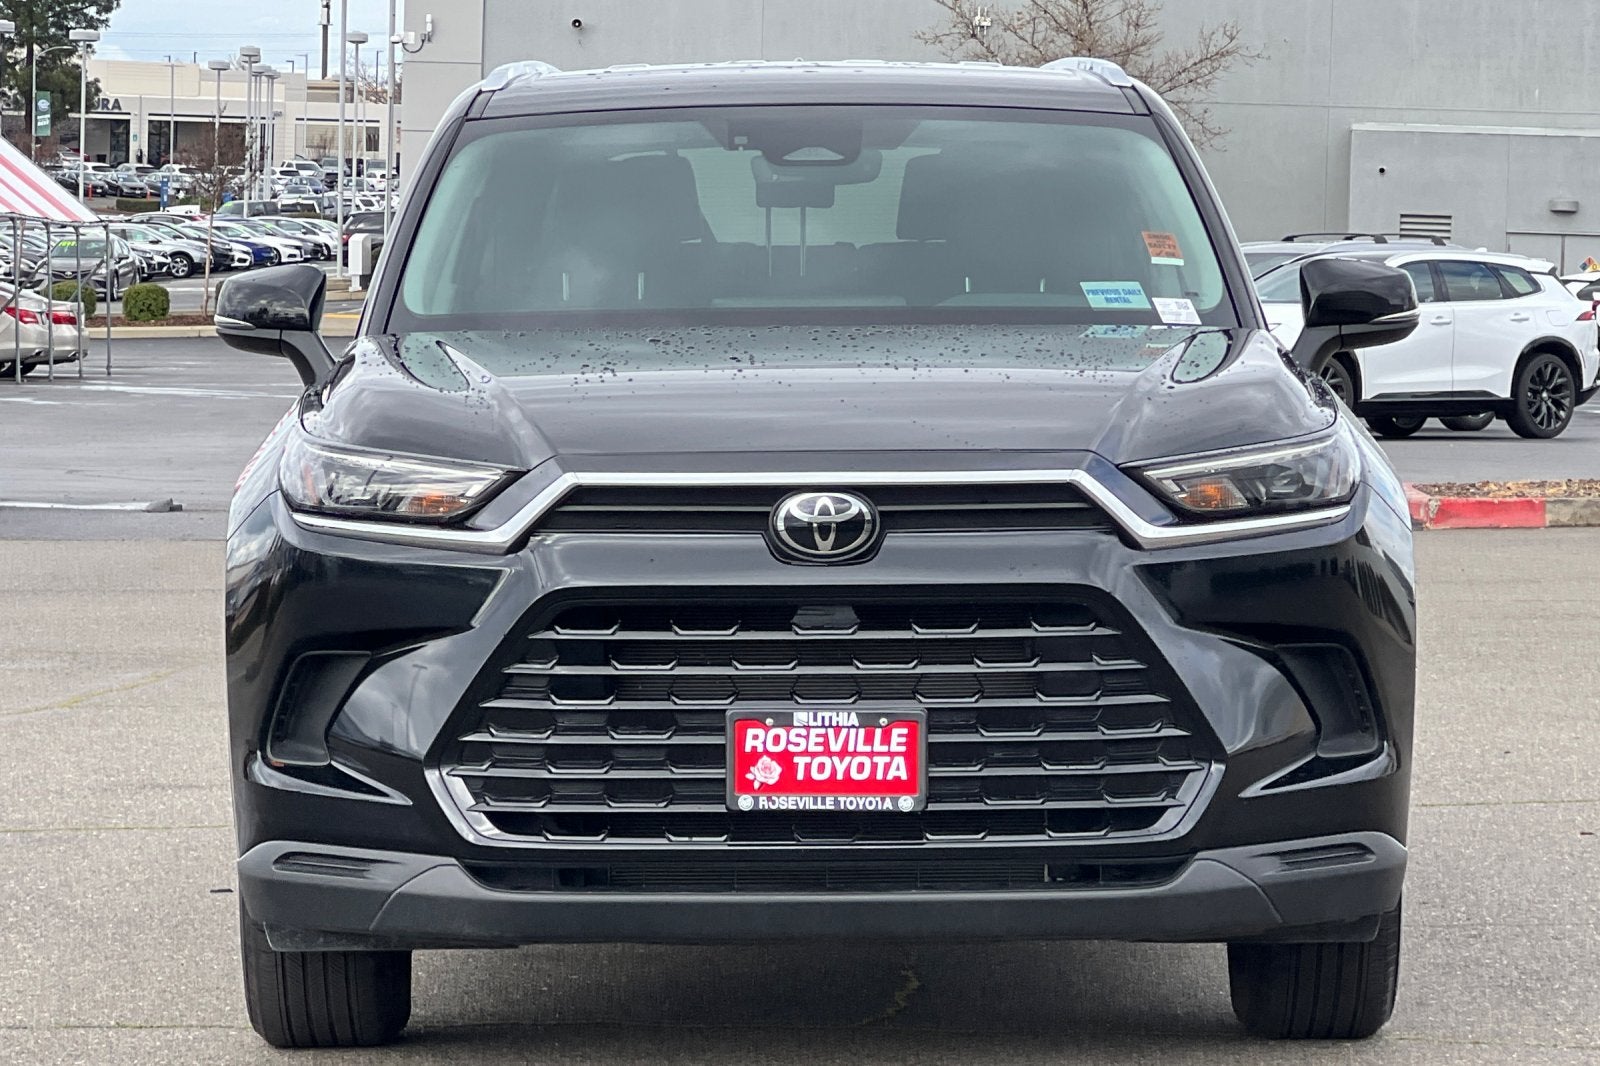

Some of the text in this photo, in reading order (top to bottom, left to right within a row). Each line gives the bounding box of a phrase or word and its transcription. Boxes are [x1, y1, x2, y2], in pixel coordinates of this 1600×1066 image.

[808, 712, 859, 727] LITHIA
[744, 727, 909, 753] ROSEVILLE
[793, 755, 908, 781] TOYOTA
[758, 797, 893, 810] ROSEVILLE TOYOTA
